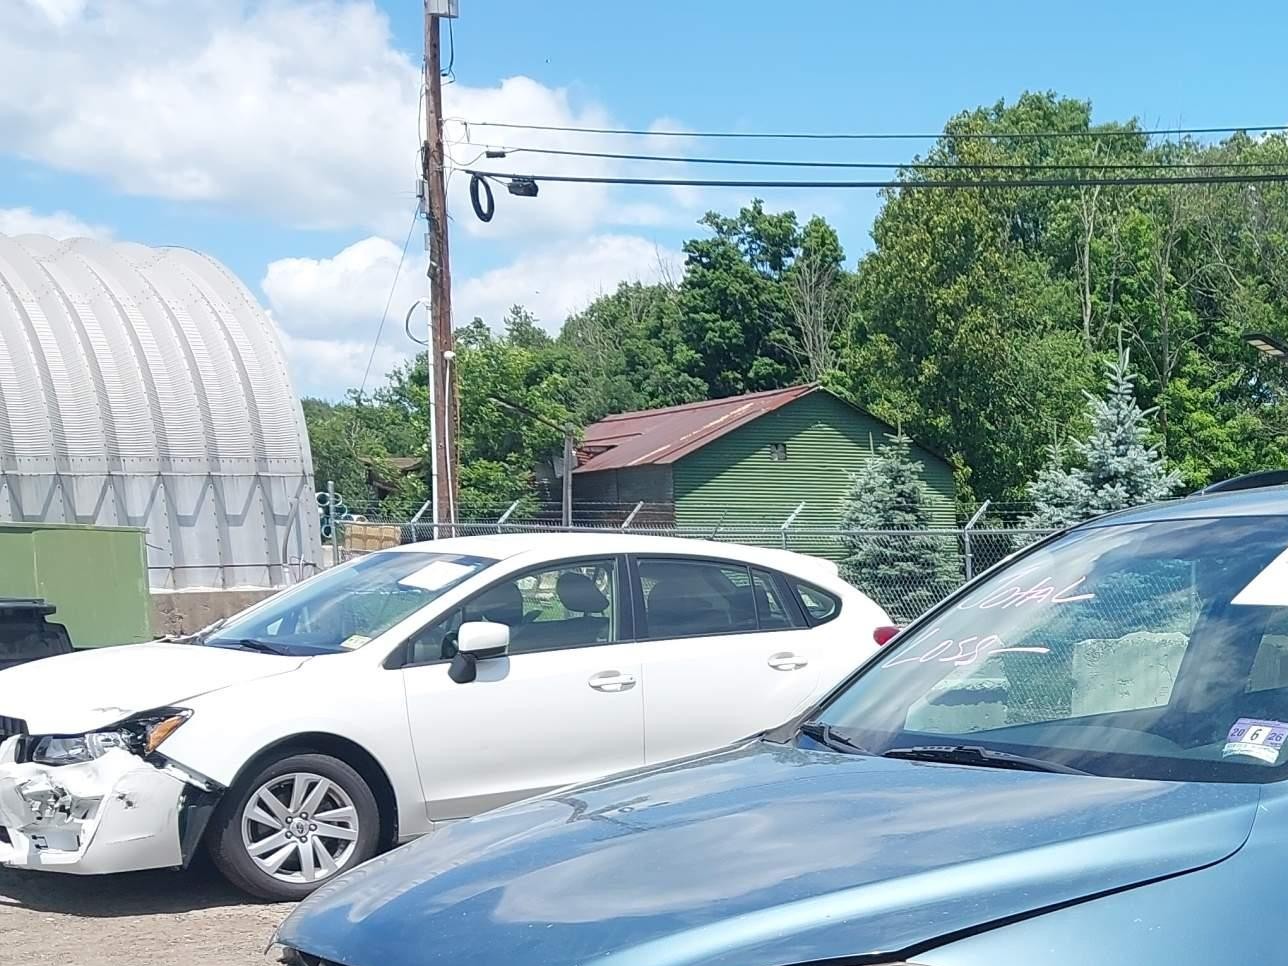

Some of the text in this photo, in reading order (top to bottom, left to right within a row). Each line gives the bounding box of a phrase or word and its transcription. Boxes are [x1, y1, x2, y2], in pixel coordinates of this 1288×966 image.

[1230, 727, 1284, 742] 20 6 26
